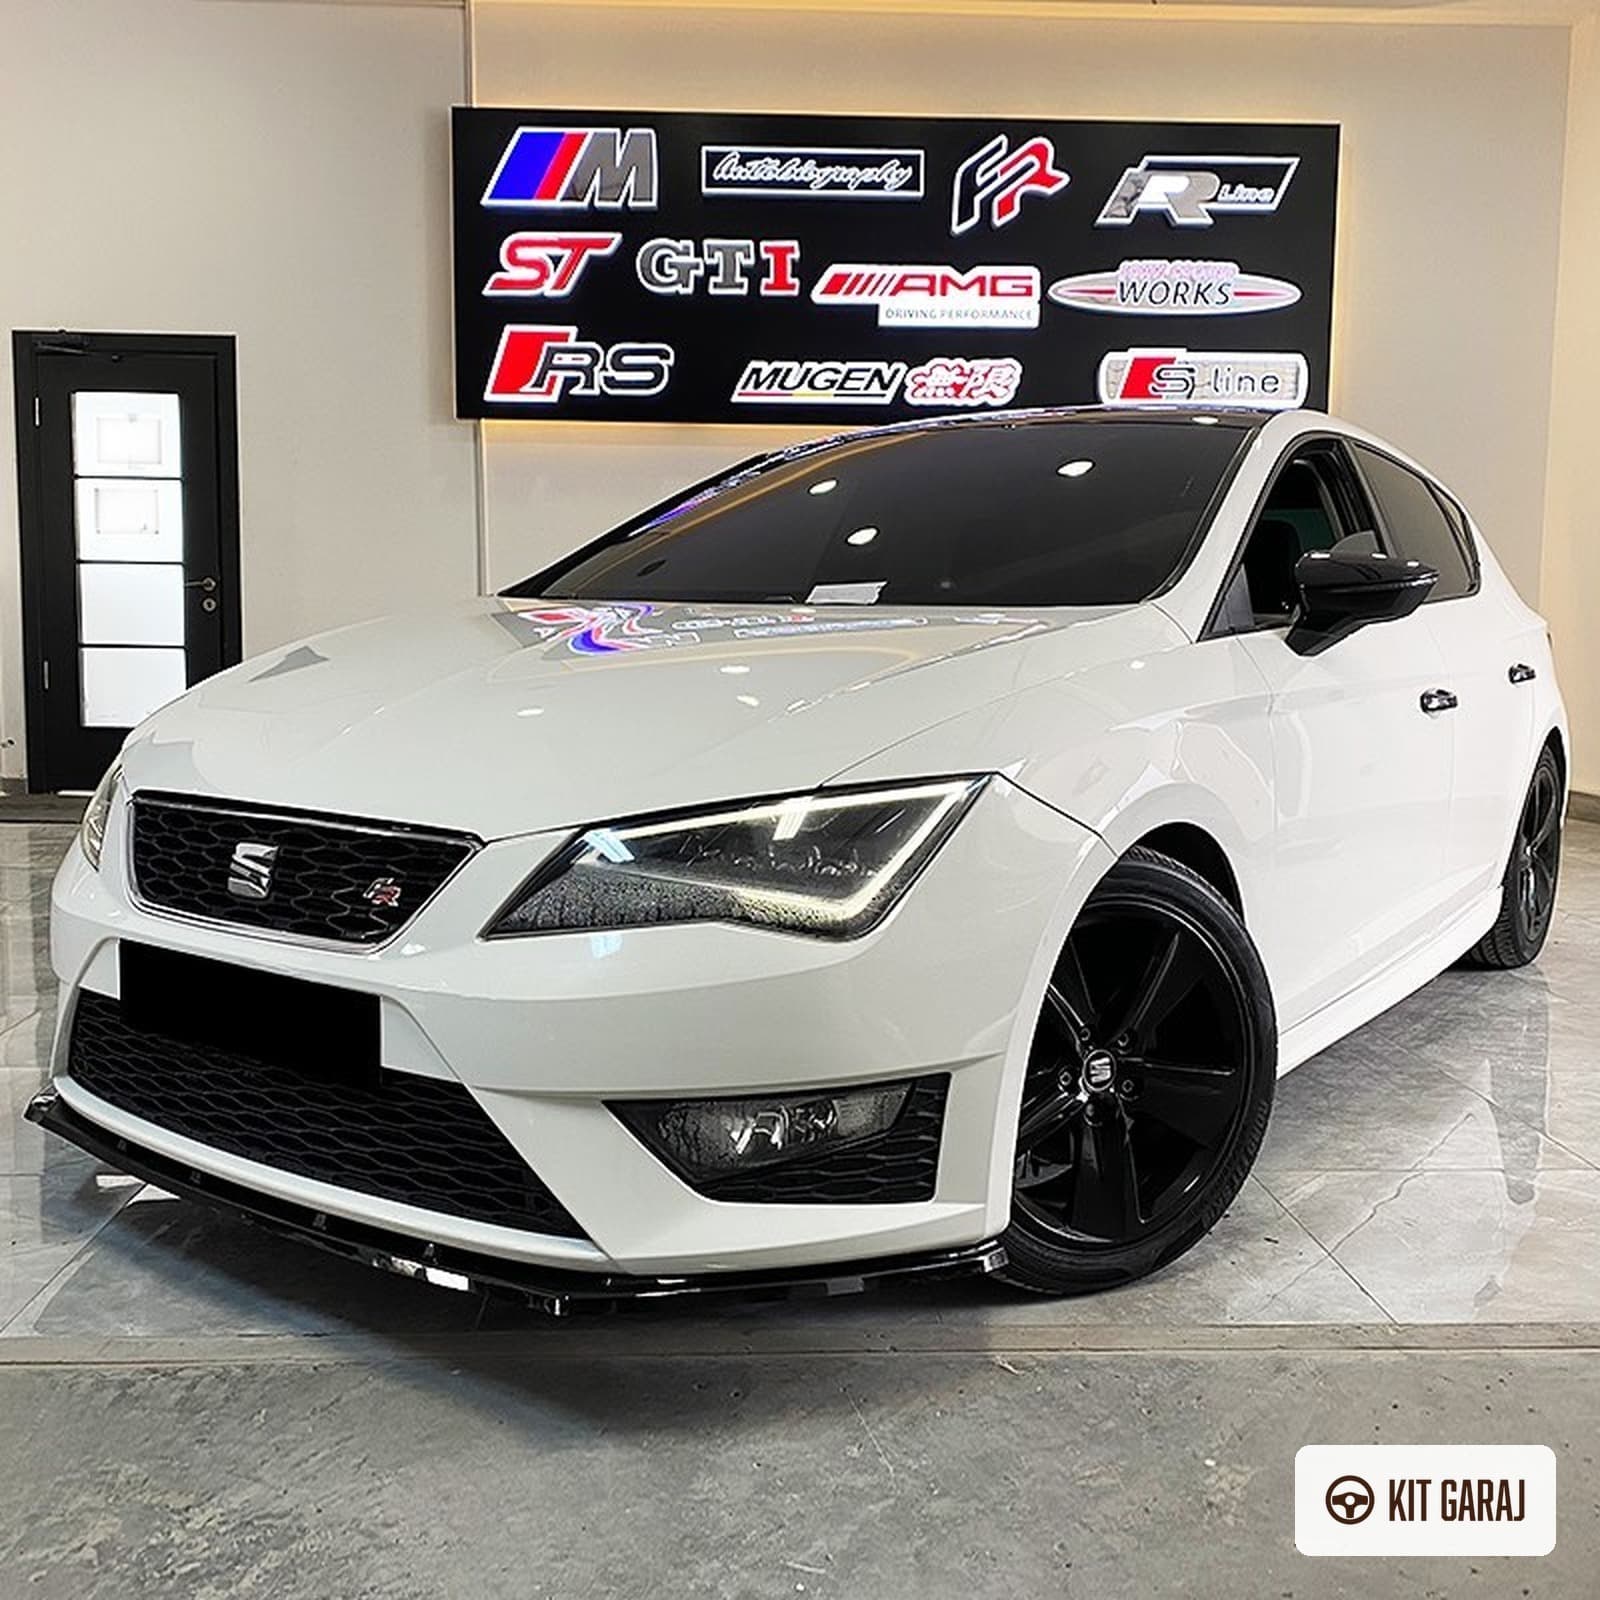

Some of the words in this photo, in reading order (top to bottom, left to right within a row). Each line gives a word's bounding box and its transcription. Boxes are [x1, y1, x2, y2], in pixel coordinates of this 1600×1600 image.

[713, 151, 912, 191] Autobiography
[482, 232, 622, 296] ST
[636, 238, 800, 295] GTI
[889, 273, 1034, 298] AMG
[1118, 280, 1231, 306] WORKS
[885, 308, 937, 320] DRIVING
[940, 309, 1033, 321] PERFORMANCE
[520, 341, 675, 396] RS
[741, 366, 900, 391] MUGEN
[1212, 367, 1280, 394] line
